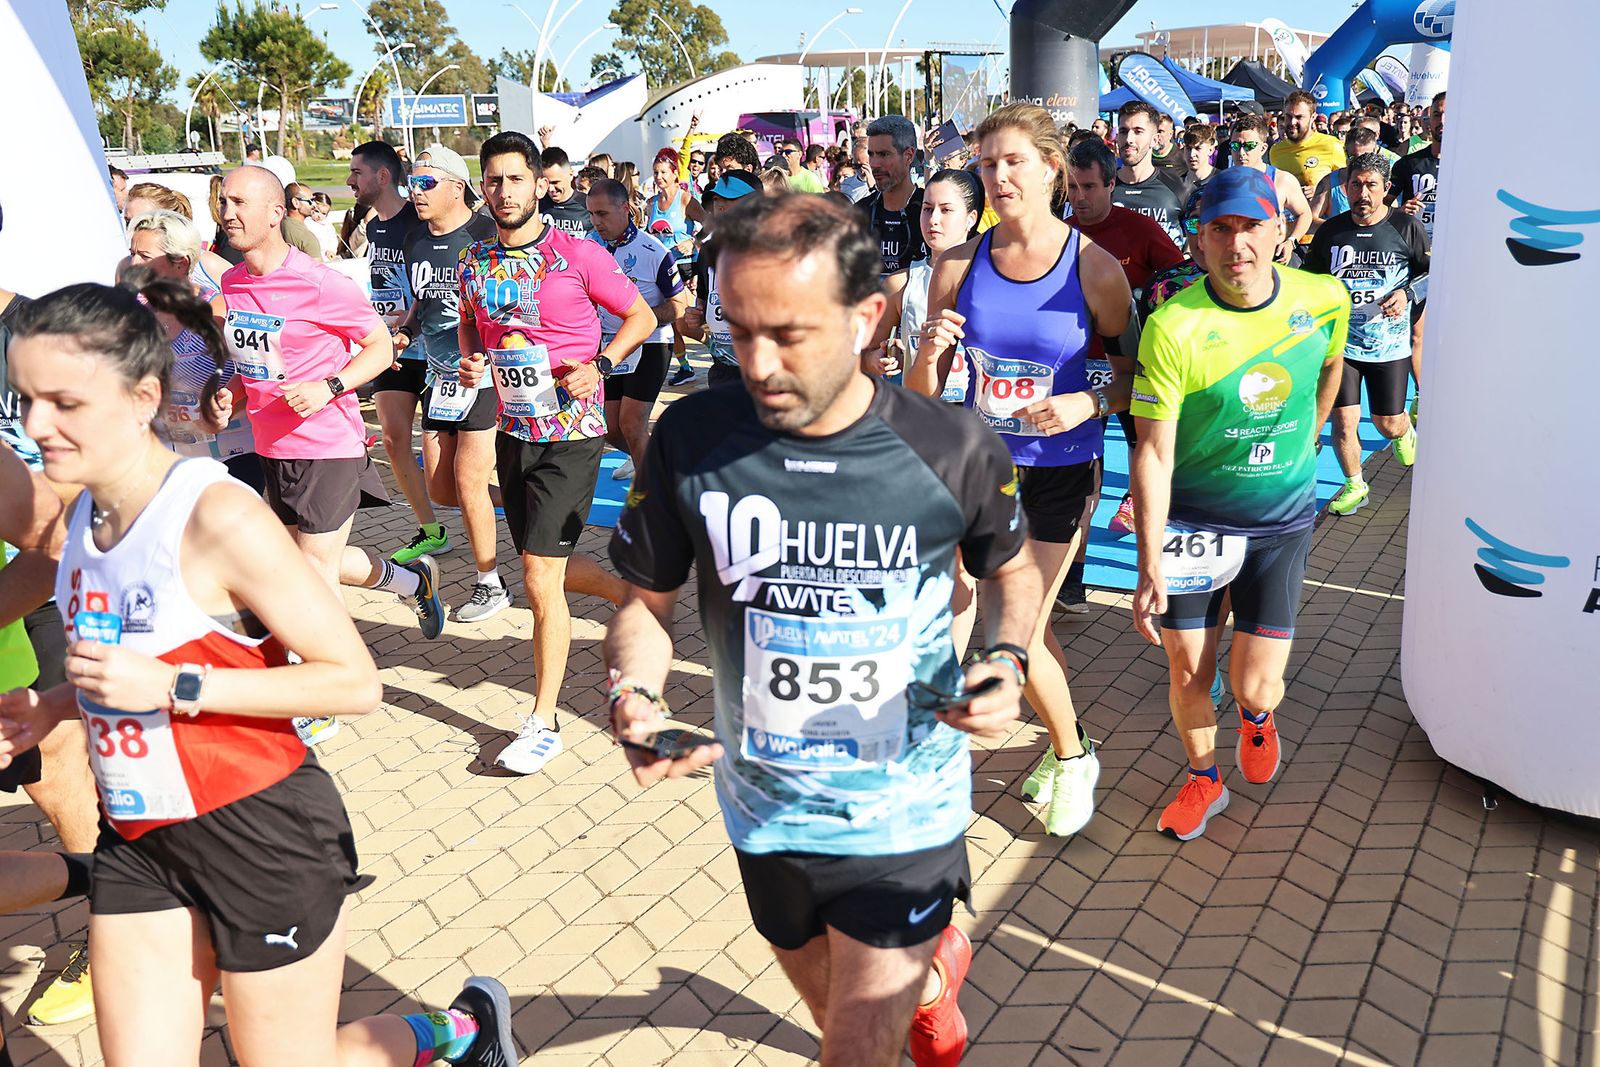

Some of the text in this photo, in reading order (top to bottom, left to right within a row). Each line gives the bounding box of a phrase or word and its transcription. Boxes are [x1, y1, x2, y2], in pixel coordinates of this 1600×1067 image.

[1047, 94, 1077, 107] eleva
[553, 219, 584, 231] HUELVA
[375, 248, 405, 263] HUELVA
[1331, 245, 1396, 277] 10 HUELVA
[412, 261, 432, 299] 10
[485, 279, 540, 323] 10 HU
[520, 291, 539, 302] EL
[520, 303, 539, 314] VA
[234, 329, 270, 352] 941
[497, 367, 539, 388] 398
[996, 364, 1028, 373] AVATEL
[1028, 364, 1047, 375] '24
[1086, 371, 1112, 386] 63
[1242, 399, 1288, 413] CAMPING
[700, 491, 919, 592] 10 HUELVA
[1163, 534, 1225, 557] 461
[781, 564, 816, 582] PUERTA
[817, 567, 835, 583] DEL
[766, 585, 854, 612] AVATE
[753, 614, 901, 648] 10 HUELVA AVATEL '24
[769, 657, 880, 704] 853
[768, 734, 849, 759] Wayalia
